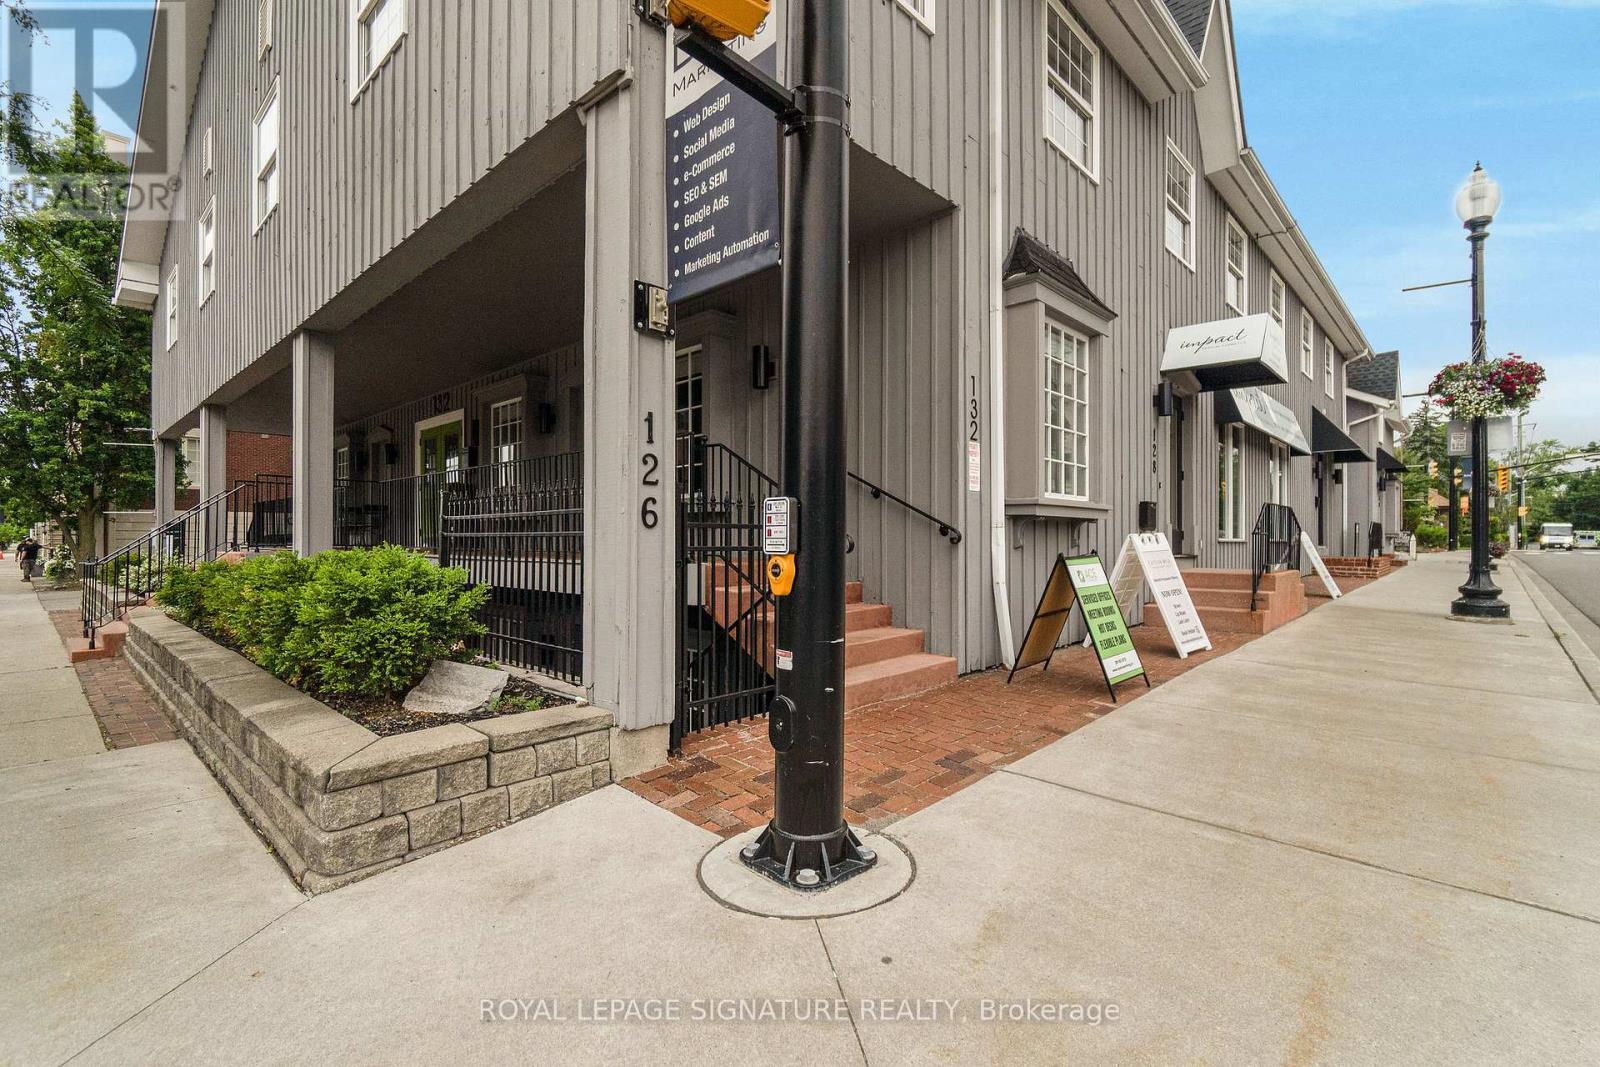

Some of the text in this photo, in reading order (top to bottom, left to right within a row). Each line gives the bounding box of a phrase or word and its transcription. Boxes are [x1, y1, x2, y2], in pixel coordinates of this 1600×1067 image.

[683, 92, 731, 133] Web Design
[683, 117, 735, 159] Social Media
[683, 142, 736, 182] e-Commerce
[683, 169, 728, 205] SEO & SEM
[684, 195, 730, 227] Google Ads
[684, 225, 715, 250] Content
[684, 229, 769, 275] Marketing Automation
[969, 375, 978, 442] 132
[641, 411, 659, 529] 126
